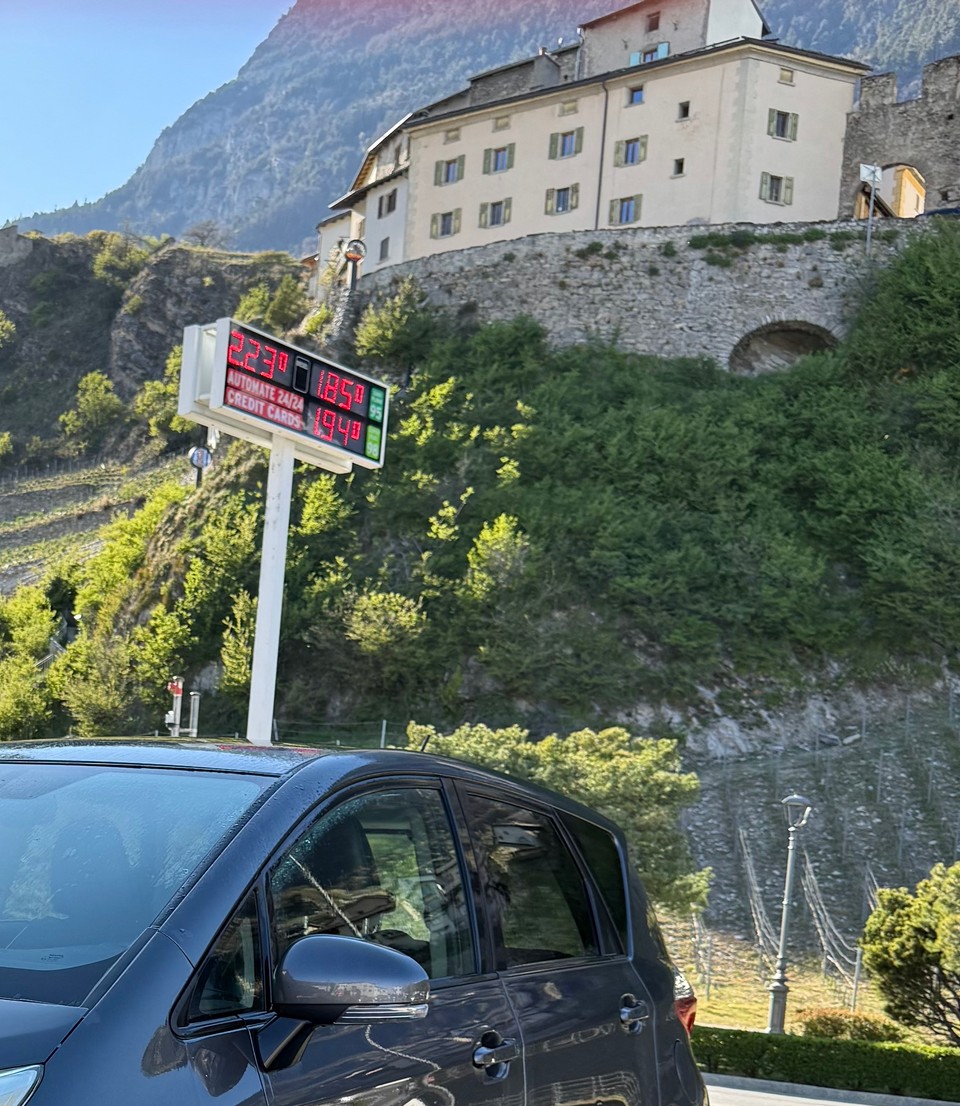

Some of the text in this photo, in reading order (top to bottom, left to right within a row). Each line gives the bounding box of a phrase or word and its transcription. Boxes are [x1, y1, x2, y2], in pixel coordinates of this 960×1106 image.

[227, 370, 304, 413] AUTOMATE 24/24
[227, 390, 301, 429] CREDIT CARDS
[369, 403, 383, 422] 95
